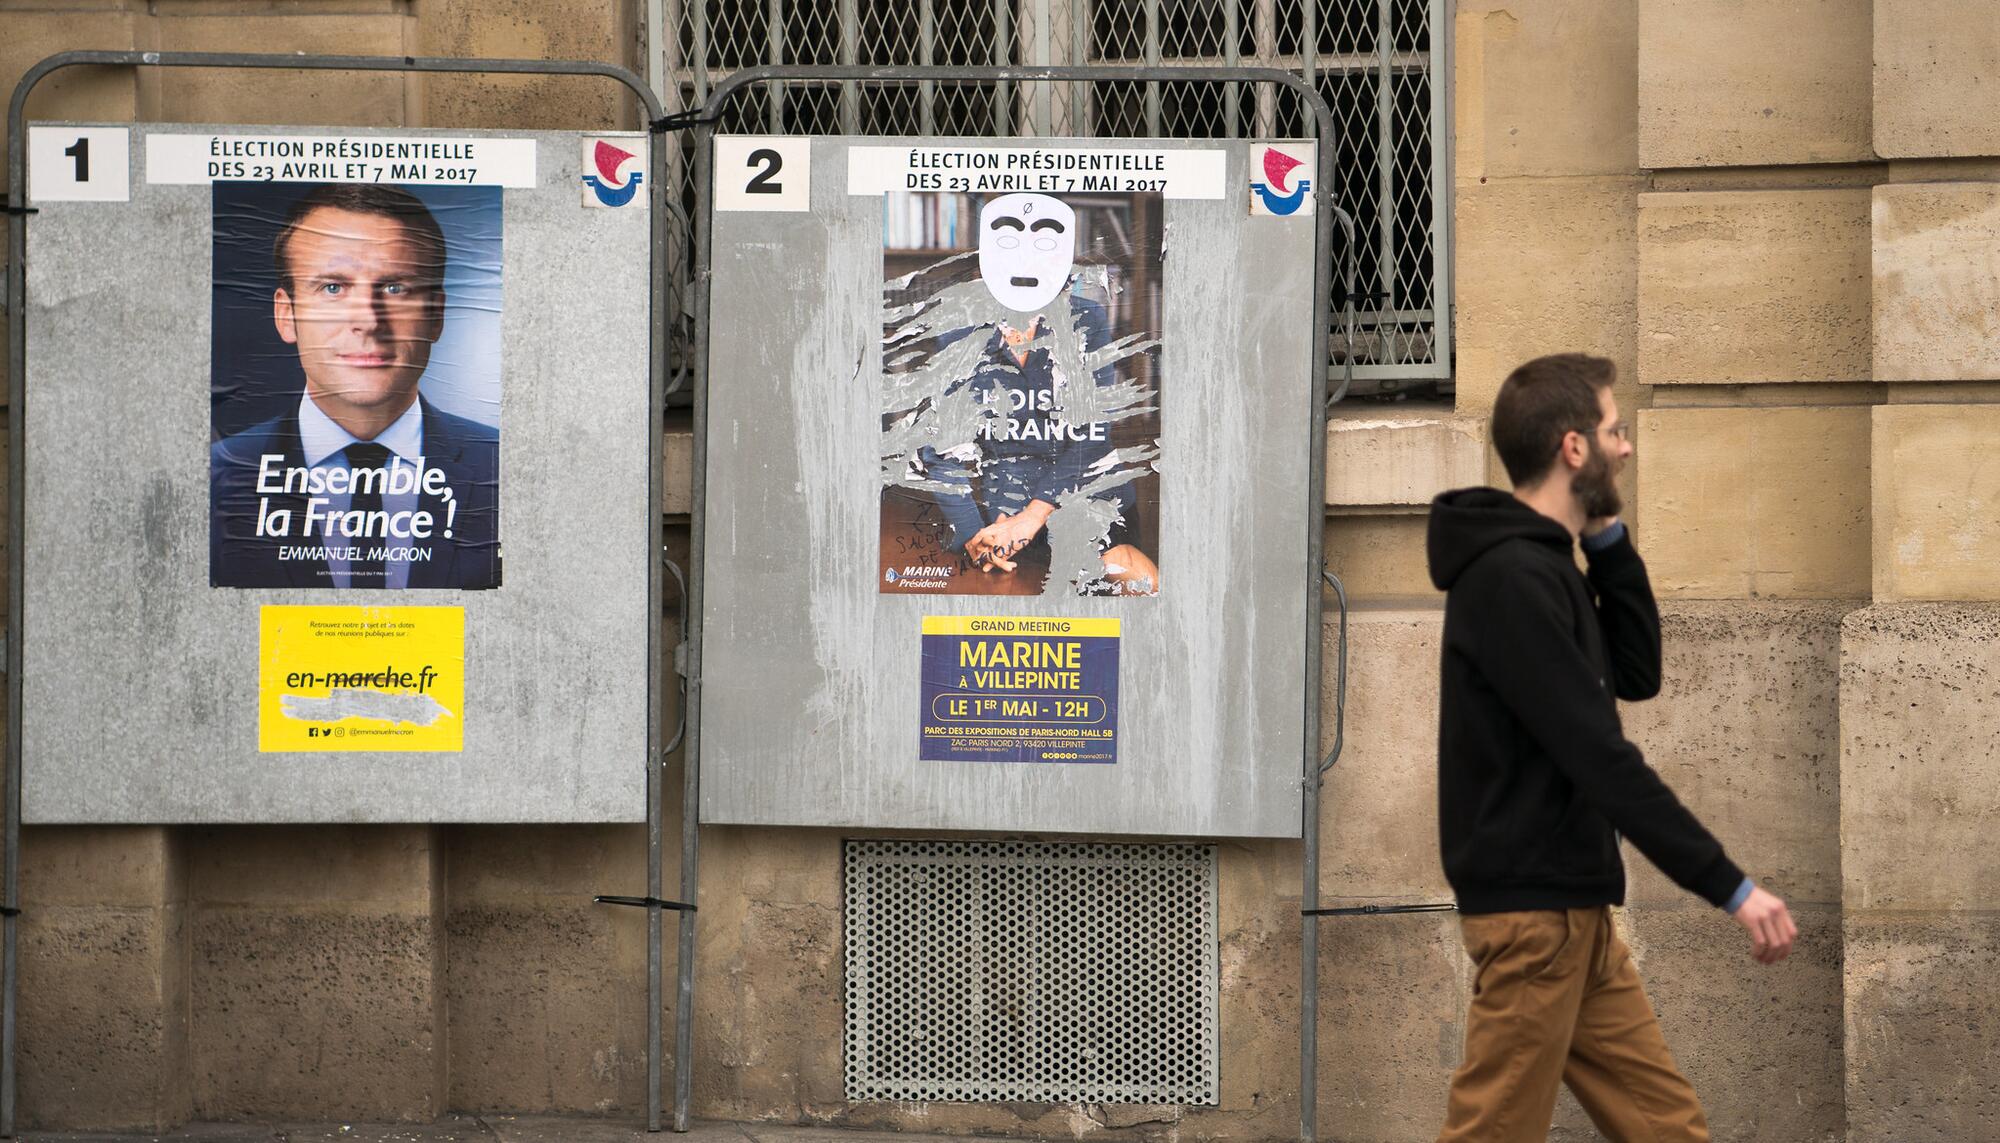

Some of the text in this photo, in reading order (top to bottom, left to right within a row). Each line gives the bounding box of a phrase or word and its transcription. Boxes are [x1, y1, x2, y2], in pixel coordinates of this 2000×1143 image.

[210, 137, 474, 159] ÉLECTION PRÉSIDENTIELLE
[65, 137, 89, 182] 1
[909, 149, 1165, 170] ÉLECTION PRÉSIDENTIELLE
[208, 162, 477, 183] DES 23 AVRIL ET 7 MAI 2017
[745, 148, 783, 194] 2
[906, 174, 1168, 192] DES 23 AVRIL ET 7 MAI 2017
[256, 454, 454, 502] Ensemble,
[255, 497, 457, 539] la France !
[278, 546, 432, 562] EMMANUEL MACRON
[902, 566, 953, 577] MARINE
[899, 578, 948, 589] Présidente
[970, 620, 1071, 632] GRAND MEETING
[959, 641, 1081, 669] MARINE
[286, 665, 438, 694] en-marche.fr
[958, 671, 1081, 690] À VILLEPINTE
[949, 699, 968, 716] LE
[1002, 700, 1038, 717] MAI
[1054, 701, 1089, 717] 12H
[924, 727, 1113, 738] PARC DES EXPOSITIONS DE PARIS-NORD HALL 5B
[951, 739, 967, 747] ZAC
[968, 739, 989, 747] PARIS
[991, 739, 1014, 748] NORD
[1023, 740, 1047, 748] 93420
[1047, 740, 1086, 749] VILLEPINTE
